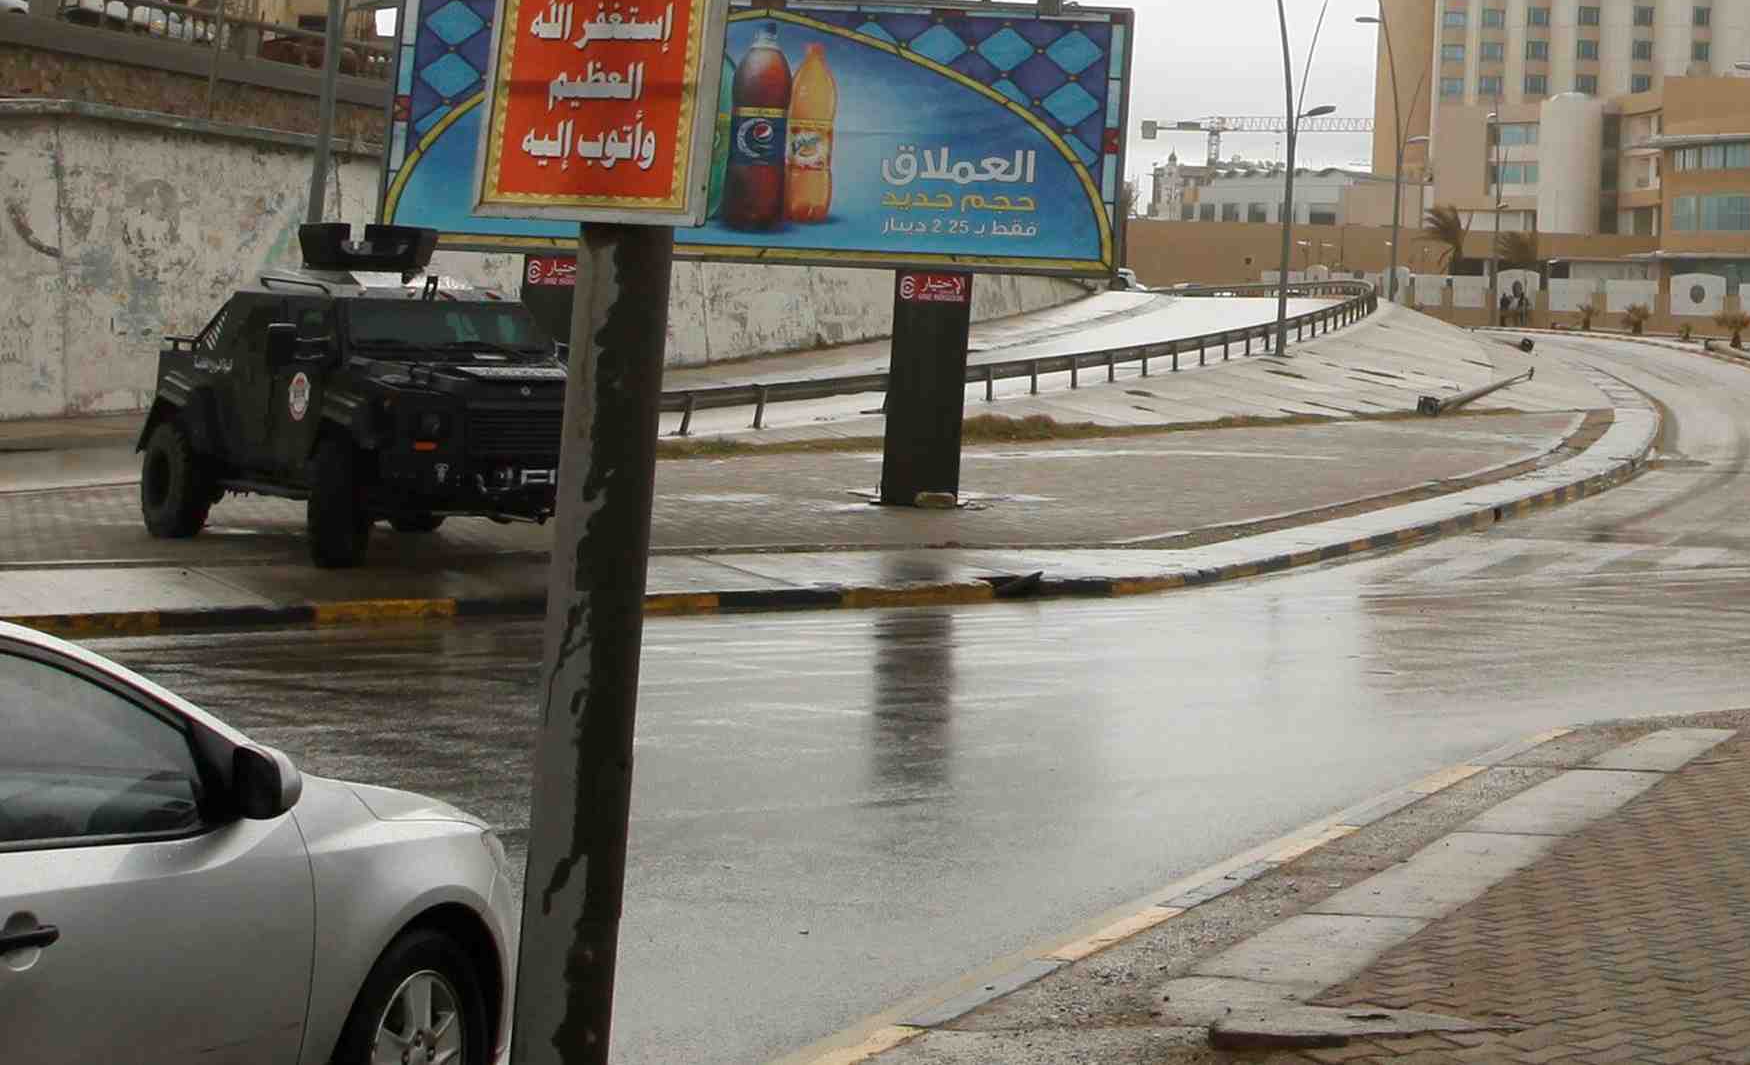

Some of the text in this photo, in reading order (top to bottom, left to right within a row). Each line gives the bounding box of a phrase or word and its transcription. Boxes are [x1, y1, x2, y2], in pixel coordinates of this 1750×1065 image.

[574, 1, 673, 53] إستغفر
[548, 62, 644, 111] العظيم
[521, 110, 656, 170] وأتوب إليه
[881, 145, 1037, 186] العملاق
[881, 190, 1037, 214] حجم جديد
[881, 216, 927, 236] دينار
[991, 218, 1039, 237] فقط
